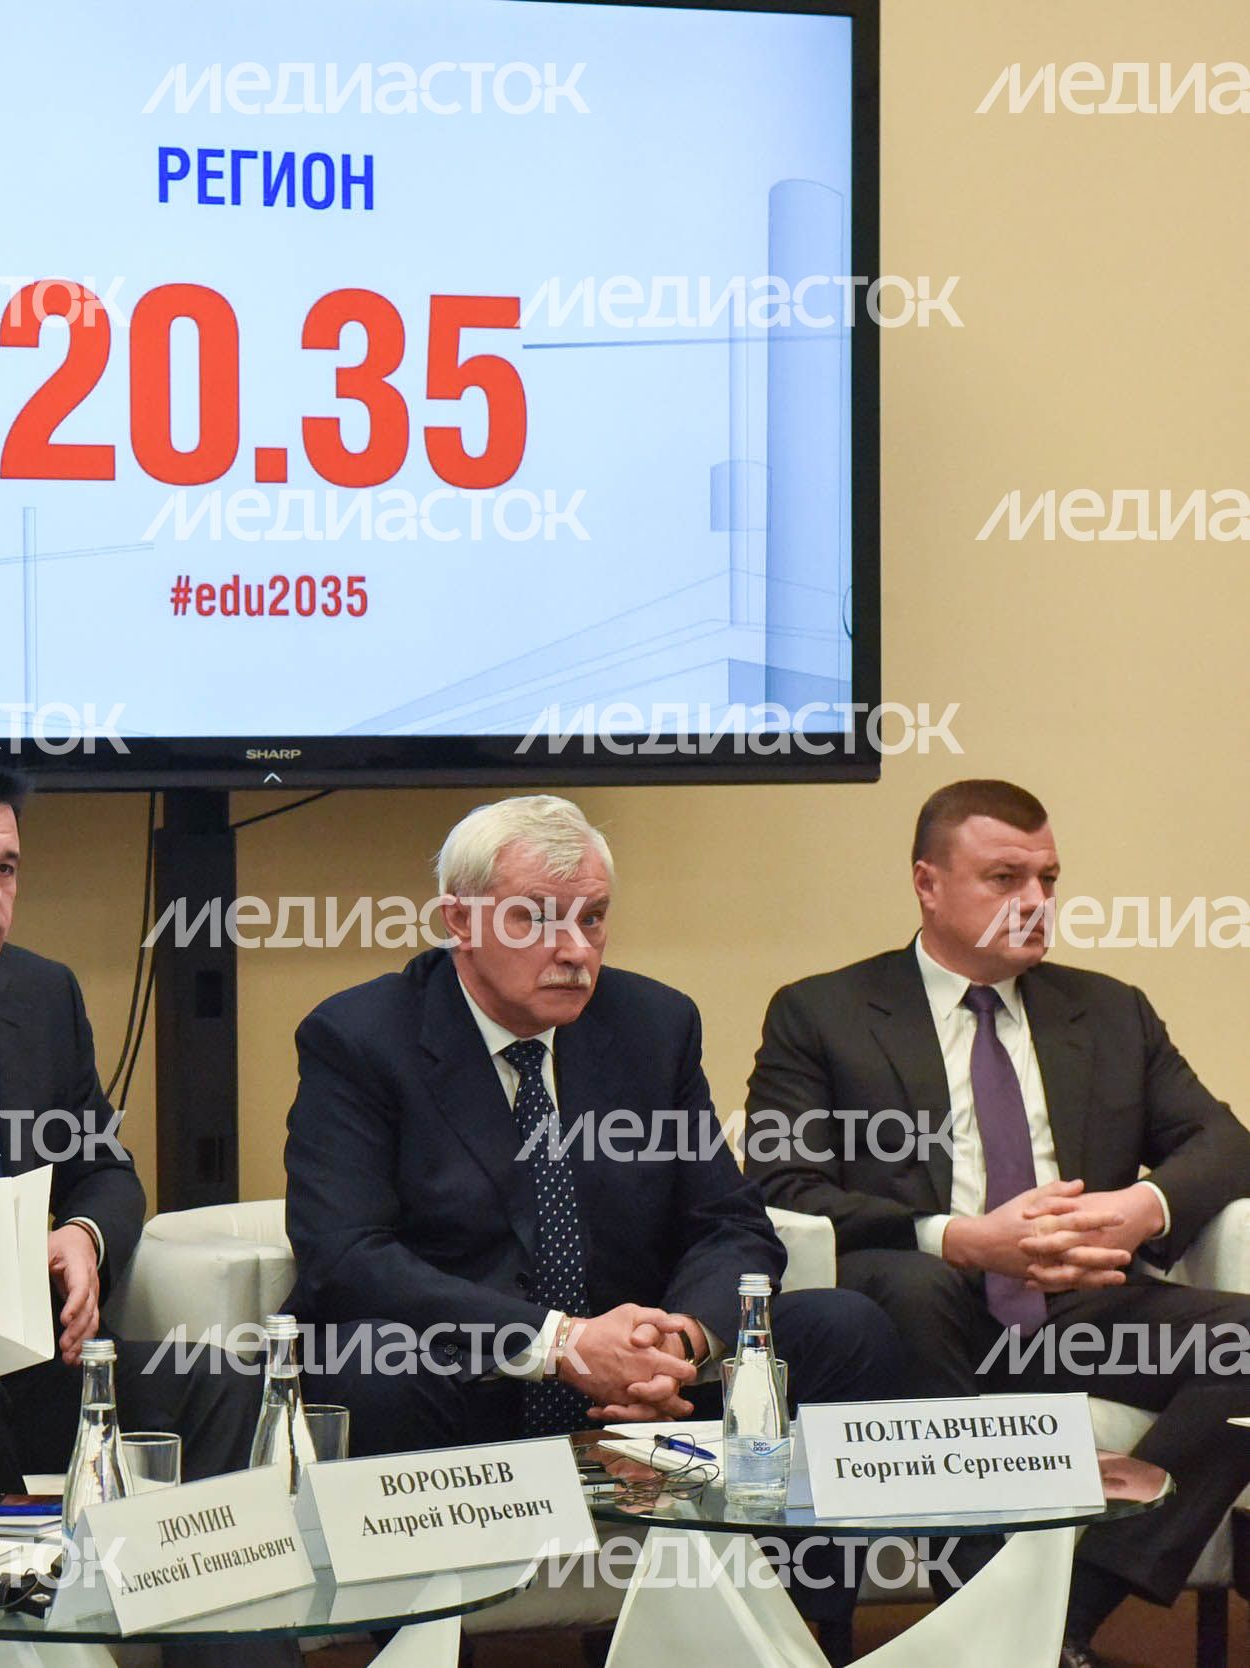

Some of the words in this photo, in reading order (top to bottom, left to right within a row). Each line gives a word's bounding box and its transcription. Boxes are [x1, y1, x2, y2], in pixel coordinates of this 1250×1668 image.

[157, 145, 376, 211] РЕГИОН
[169, 574, 369, 618] #edu2035
[245, 748, 303, 760] SHARP
[842, 1413, 1059, 1443] ПОЛТАВЧЕНКО
[378, 1461, 514, 1497] ВОРОБЬЕВ
[834, 1454, 937, 1484] Георгий
[943, 1452, 1073, 1480] Сергеевич
[156, 1504, 238, 1550] ДЮМИН
[361, 1506, 444, 1538] Андрей
[446, 1499, 554, 1529] Юрьевич
[120, 1557, 191, 1596] Алексей
[191, 1535, 297, 1577] Геннадьевич
